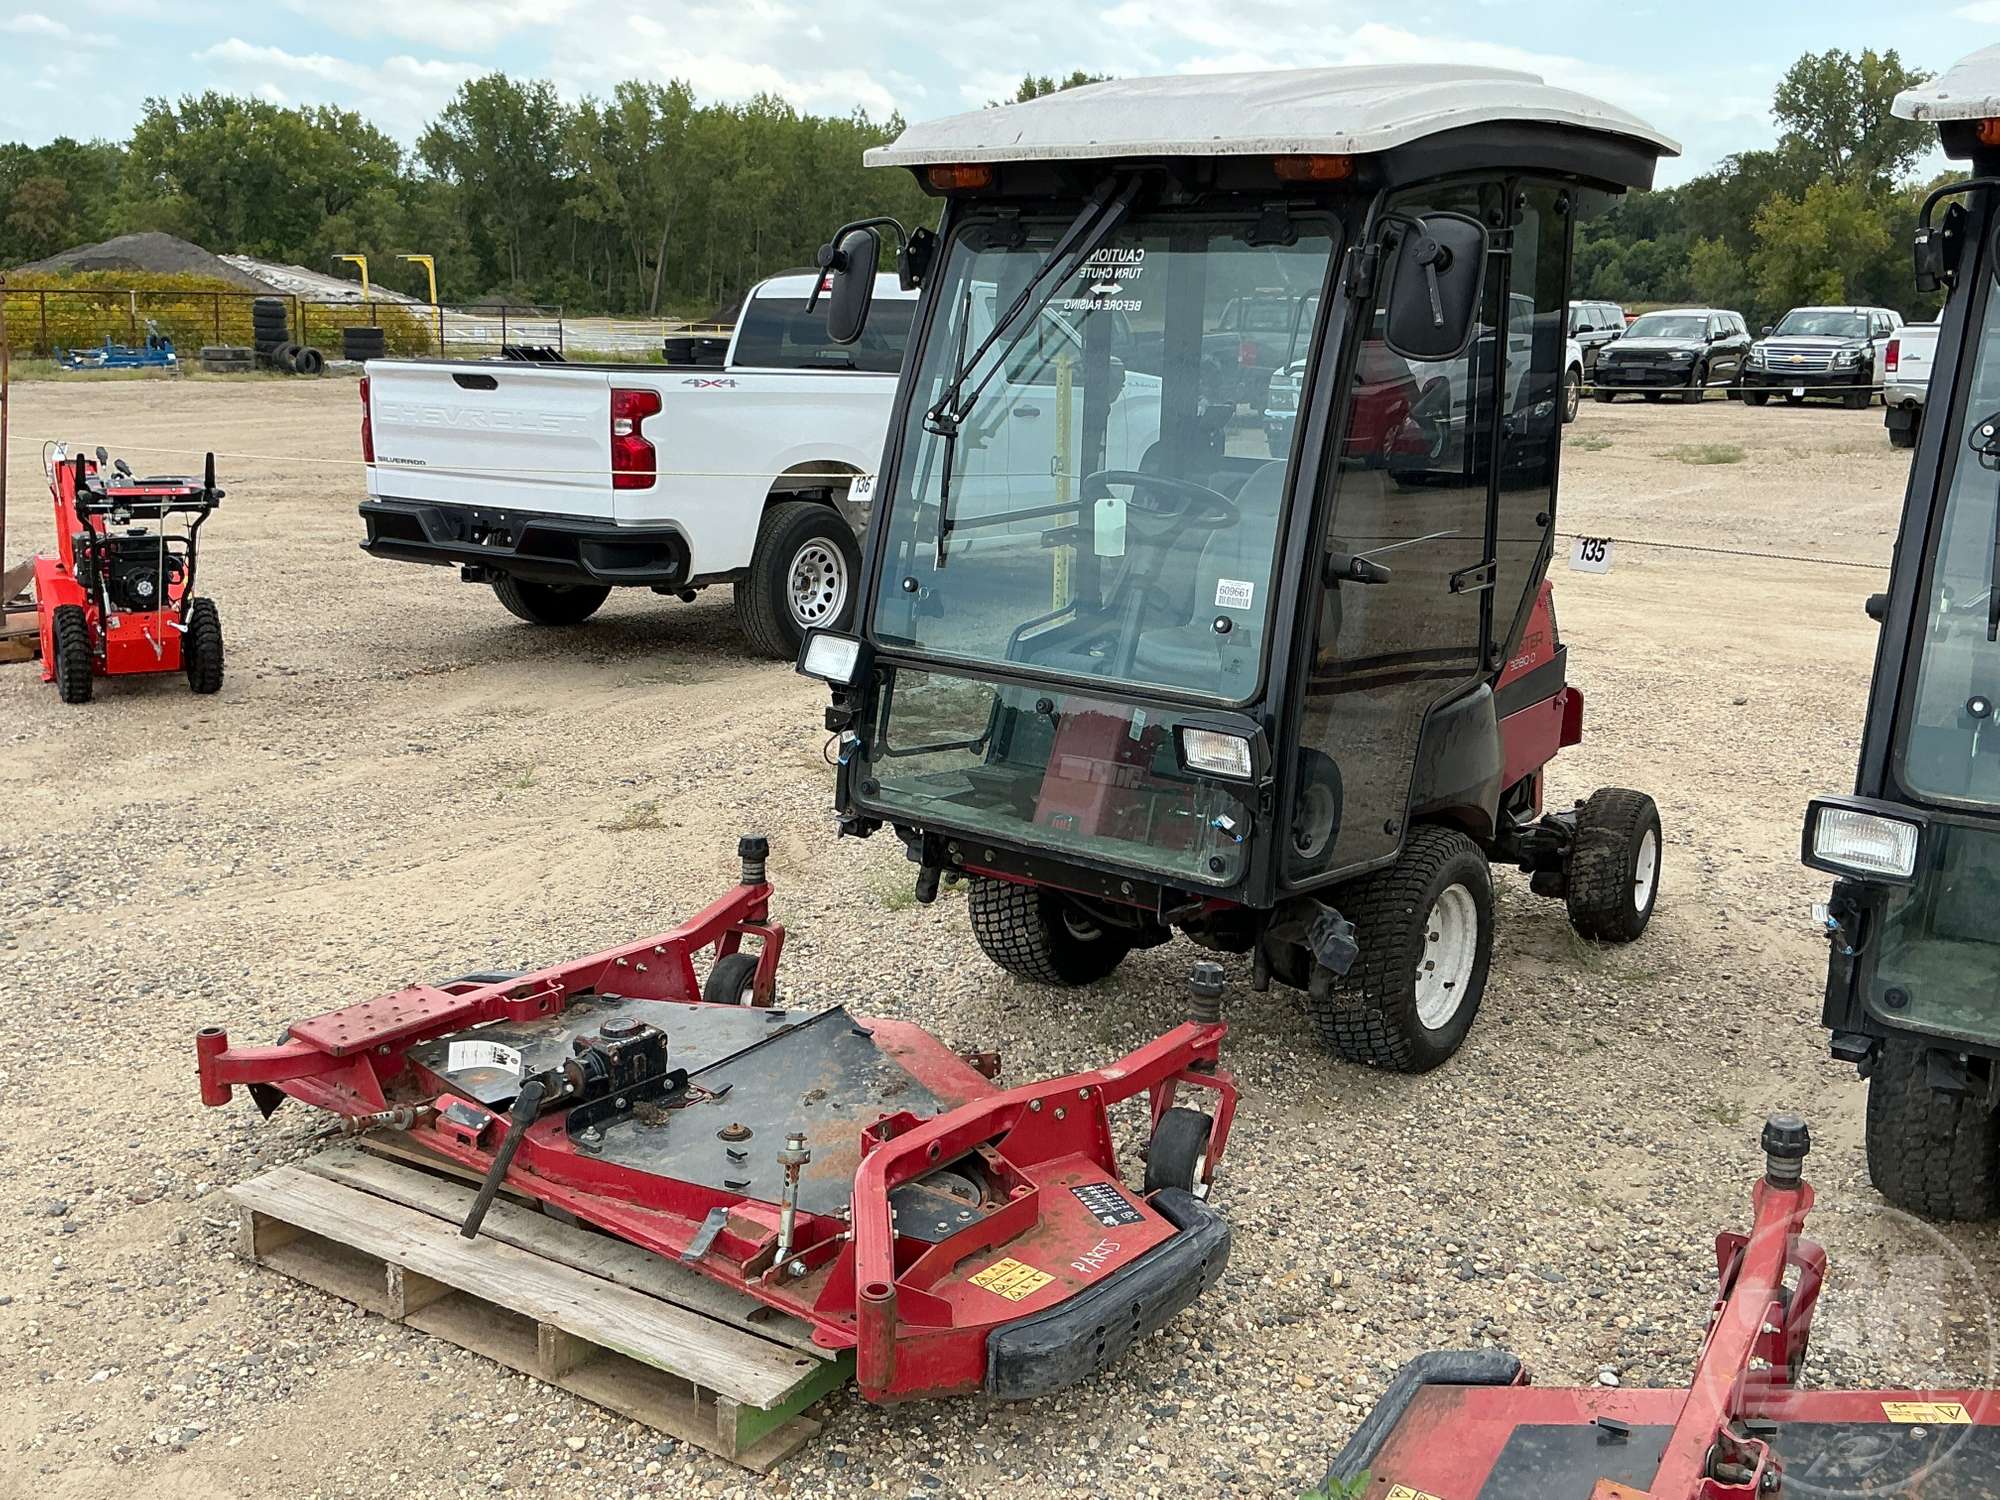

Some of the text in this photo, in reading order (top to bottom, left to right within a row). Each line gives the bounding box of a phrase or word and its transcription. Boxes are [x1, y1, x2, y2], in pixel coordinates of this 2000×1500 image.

[379, 403, 588, 432] CHEVROLET
[377, 455, 427, 466] SILVERADO
[855, 476, 871, 493] 136
[1581, 538, 1606, 562] 135
[1070, 1238, 1121, 1274] PARTS
